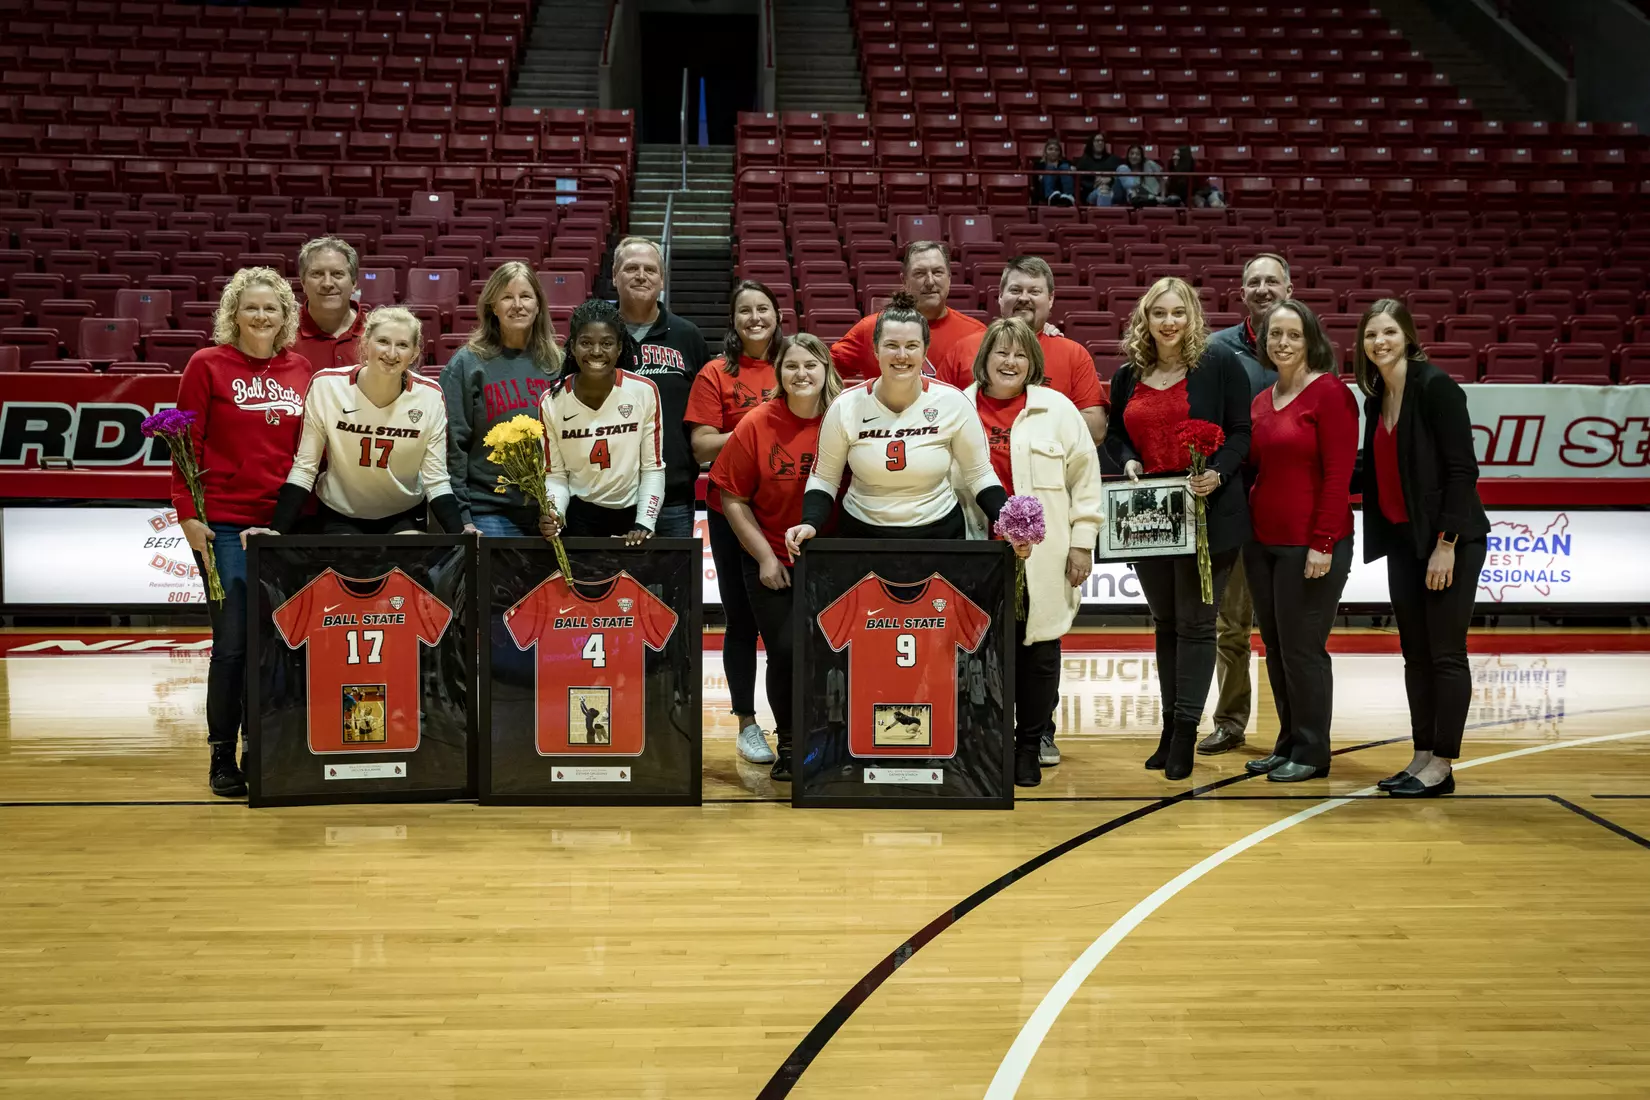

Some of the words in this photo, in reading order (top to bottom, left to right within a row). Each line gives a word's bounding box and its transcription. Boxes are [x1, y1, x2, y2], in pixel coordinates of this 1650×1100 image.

[641, 344, 685, 370] STATE
[232, 376, 266, 404] Ball
[266, 378, 303, 406] State
[484, 378, 528, 422] BALL
[336, 421, 373, 434] BALL
[375, 426, 420, 438] STATE
[562, 429, 593, 439] BALL
[595, 422, 638, 436] STATE
[859, 430, 892, 439] BALL
[895, 426, 939, 438] STATE
[359, 437, 394, 469] 17
[589, 438, 611, 470] 4
[1559, 416, 1650, 468] St
[886, 440, 906, 471] 9
[143, 537, 185, 548] BEST
[1487, 534, 1571, 556] RICAN
[1490, 554, 1524, 566] EST
[1481, 570, 1571, 583] SSIONALS
[323, 613, 359, 627] BALL
[362, 613, 406, 625] STATE
[553, 617, 588, 630] BALL
[592, 616, 634, 628] STATE
[865, 618, 900, 630] BALL
[904, 618, 946, 629] STATE
[346, 630, 384, 665] 17
[582, 633, 606, 668] 4
[896, 634, 916, 668] 9
